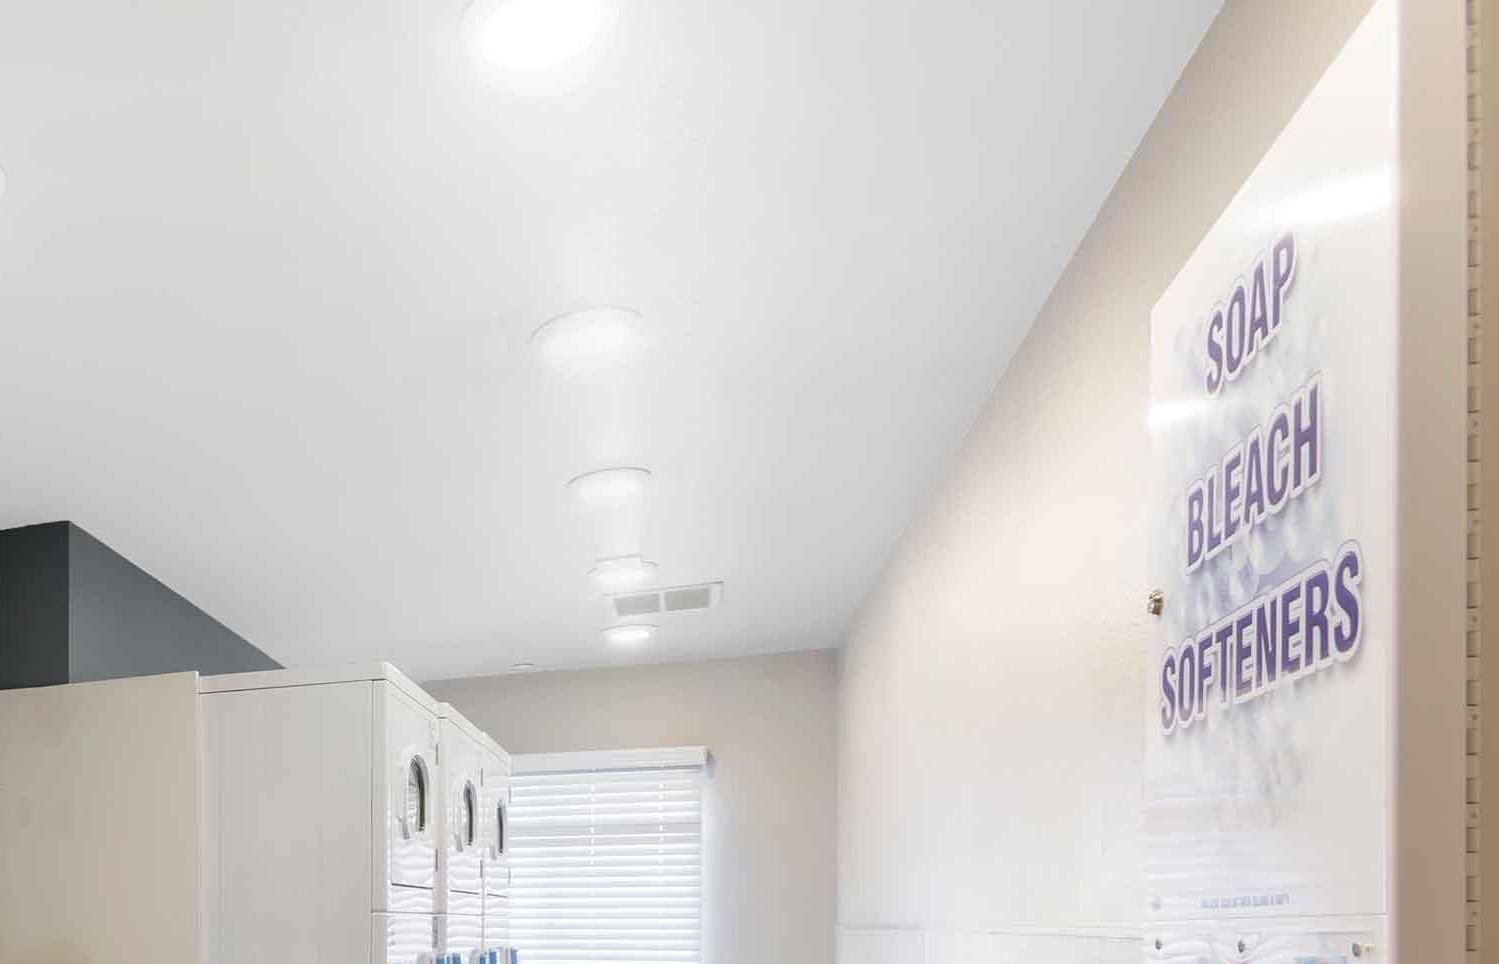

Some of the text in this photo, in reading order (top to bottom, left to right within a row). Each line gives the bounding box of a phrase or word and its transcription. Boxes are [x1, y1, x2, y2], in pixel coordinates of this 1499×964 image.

[1207, 233, 1295, 393] SOAP
[1187, 383, 1321, 568] BLEACH
[1161, 550, 1361, 731] SOFTENERS
